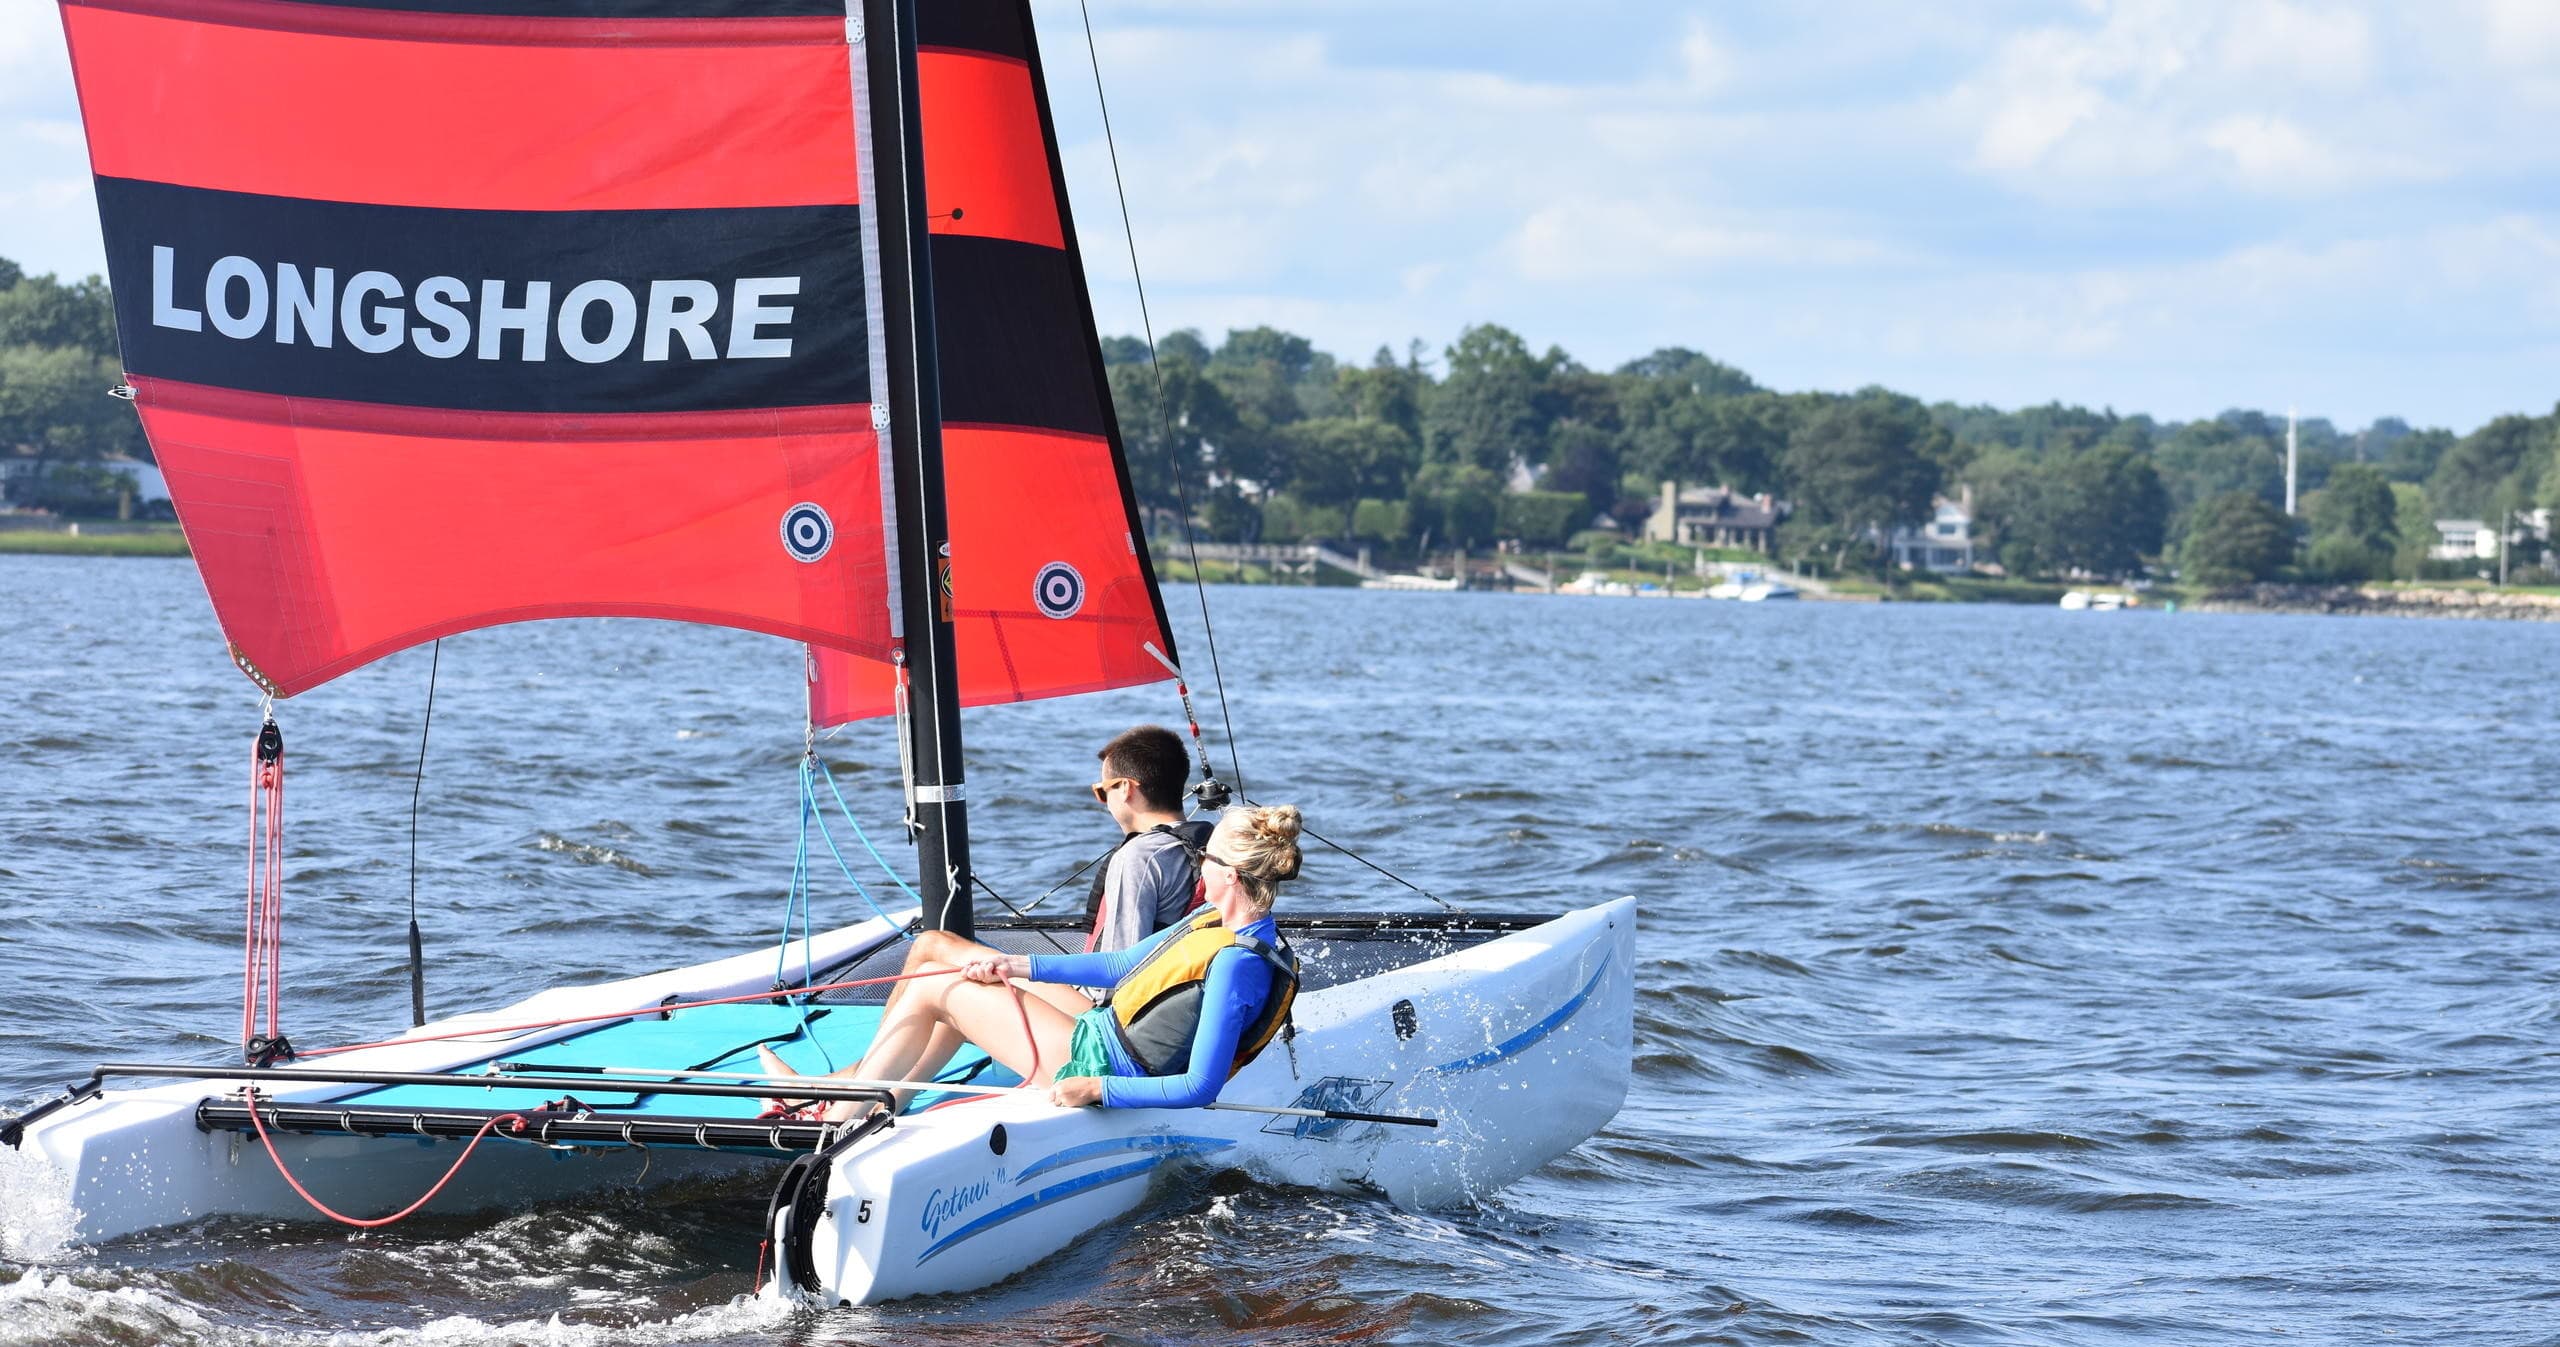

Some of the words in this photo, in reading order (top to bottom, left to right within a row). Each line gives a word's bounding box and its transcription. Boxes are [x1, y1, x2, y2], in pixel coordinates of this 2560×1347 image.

[152, 245, 801, 363] LONGSHORE
[857, 1199, 873, 1224] 5
[921, 1168, 1008, 1240] Getaw
